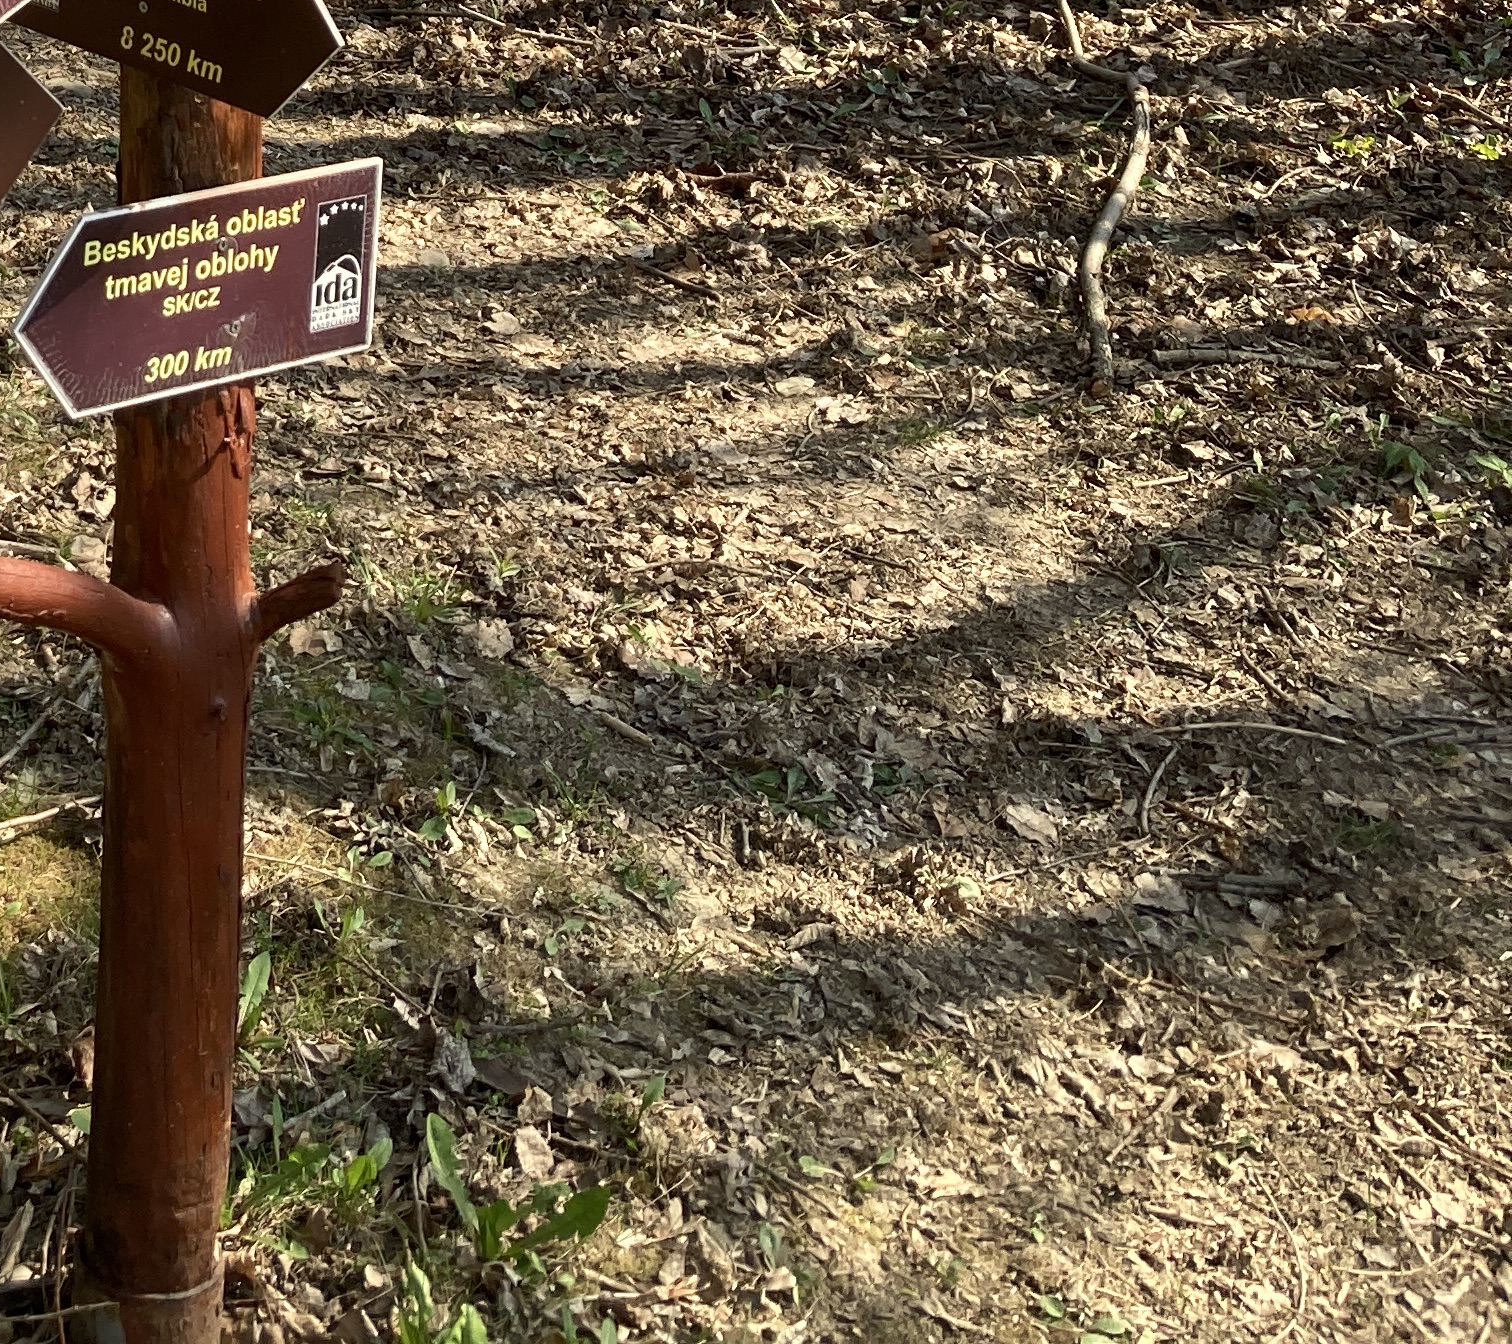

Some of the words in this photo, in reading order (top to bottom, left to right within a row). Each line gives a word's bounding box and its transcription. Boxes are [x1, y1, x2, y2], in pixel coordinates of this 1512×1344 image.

[120, 25, 134, 51] 8
[140, 32, 181, 67] 250
[186, 45, 224, 84] km
[83, 215, 220, 268] Beskydská
[225, 197, 306, 238] oblasť
[105, 259, 189, 302] tmavej
[195, 243, 279, 281] oblohy
[161, 286, 221, 318] SK/CZ
[144, 351, 190, 384] 300
[194, 345, 233, 373] km
